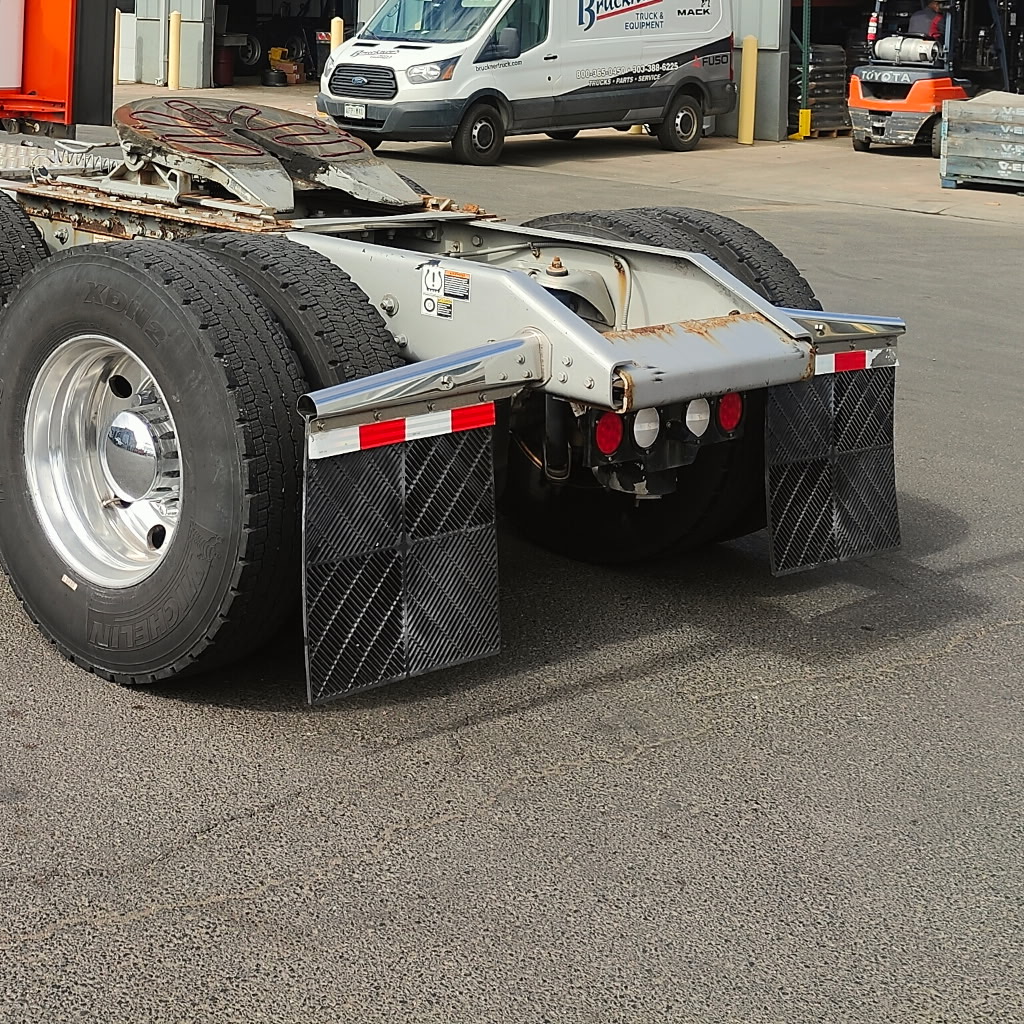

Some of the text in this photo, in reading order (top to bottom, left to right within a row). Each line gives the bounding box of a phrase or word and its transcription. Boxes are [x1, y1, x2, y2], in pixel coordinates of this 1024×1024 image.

[636, 12, 658, 21] TRUCK
[677, 8, 711, 16] MACK
[624, 21, 664, 30] EQUIPMENT
[702, 55, 729, 66] FUSO
[632, 62, 679, 74] 303-388-6225
[588, 74, 661, 87] TRUCKS PARTS SERVICE
[861, 70, 911, 83] TOYOTA
